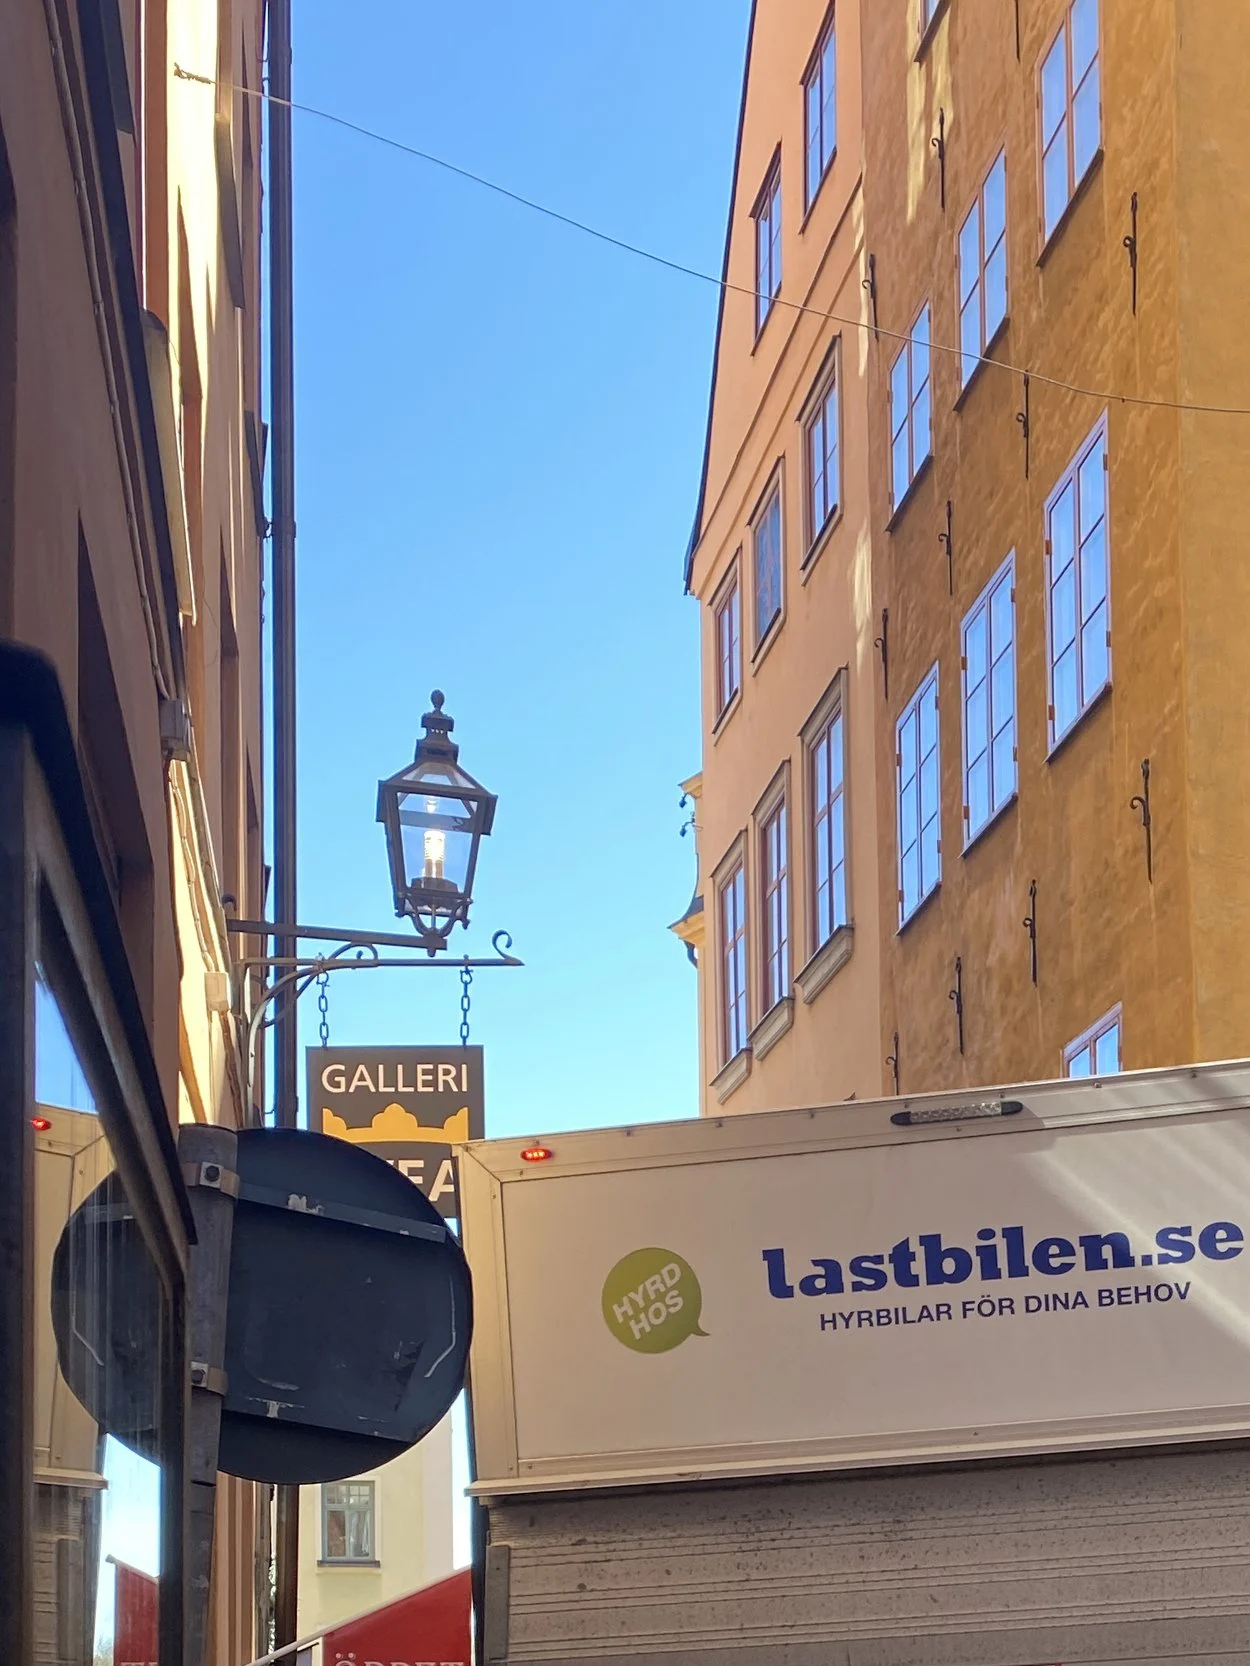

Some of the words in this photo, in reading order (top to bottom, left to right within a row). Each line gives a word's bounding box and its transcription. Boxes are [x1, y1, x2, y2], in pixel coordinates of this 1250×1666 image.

[321, 1063, 468, 1094] GALLERI
[761, 1220, 1245, 1299] lastbilen.se
[612, 1262, 682, 1324] HYRD
[629, 1289, 684, 1340] HOS
[819, 1302, 953, 1332] HYRBILAR
[961, 1294, 1016, 1319] FÖR
[1024, 1290, 1090, 1315] DINA
[1097, 1281, 1192, 1308] BEHOV
